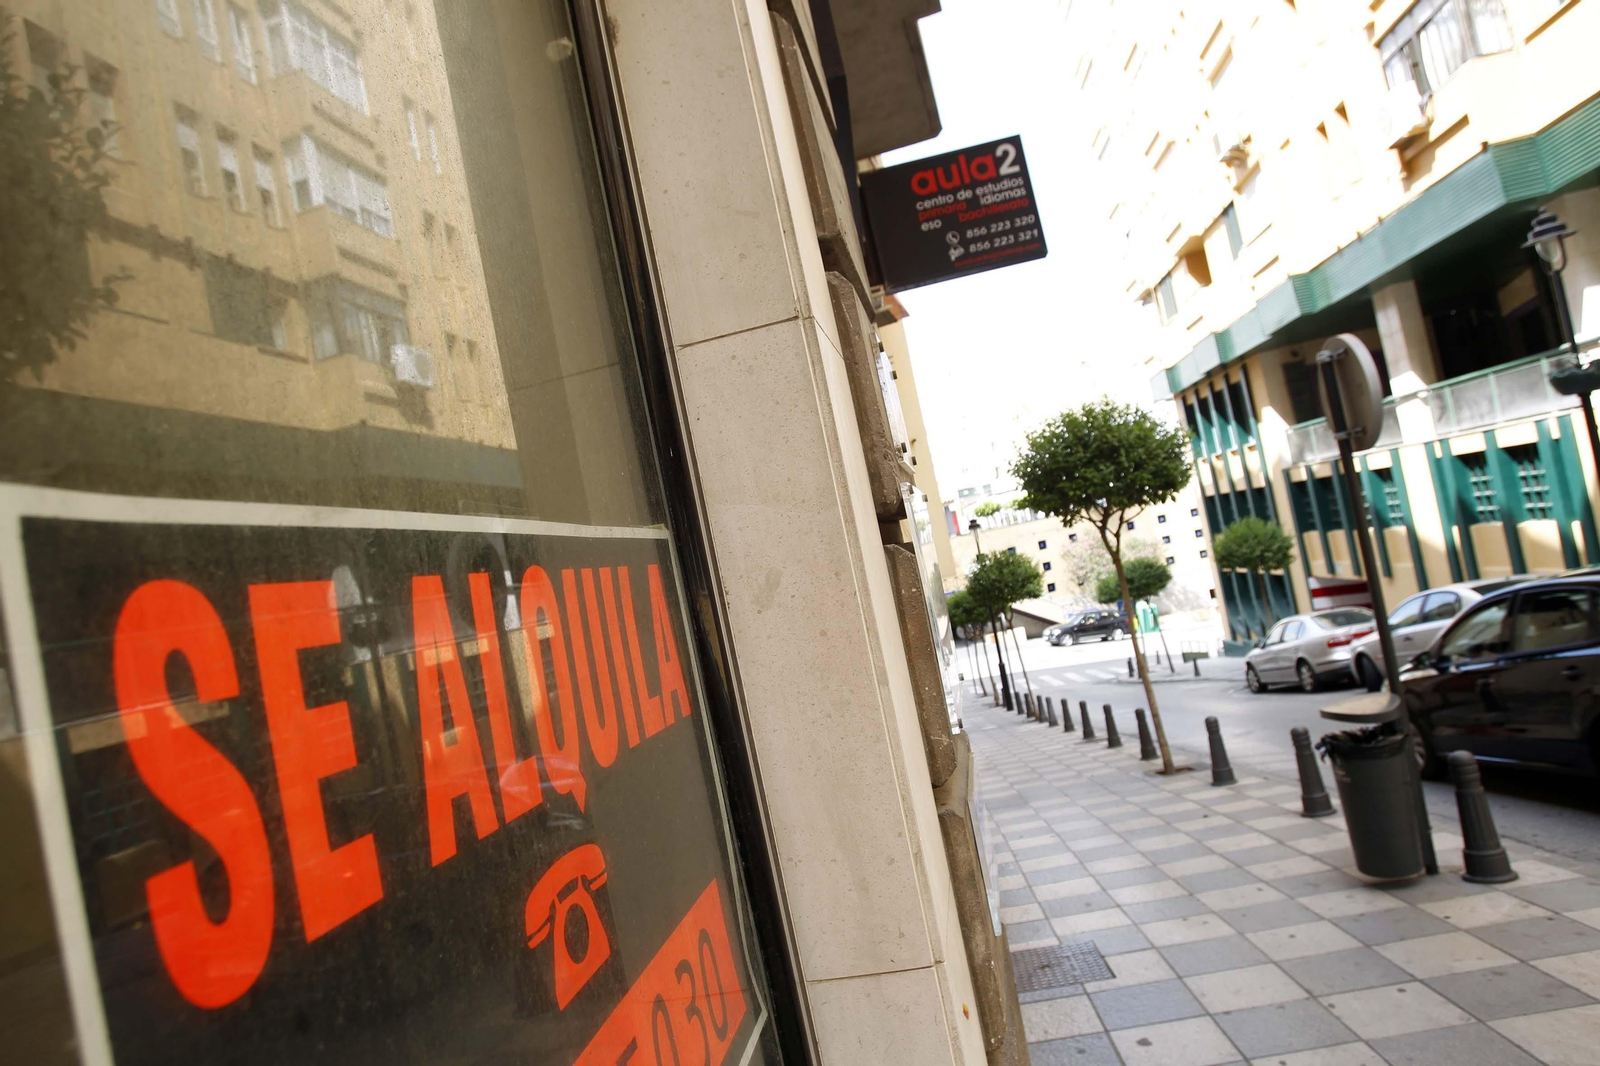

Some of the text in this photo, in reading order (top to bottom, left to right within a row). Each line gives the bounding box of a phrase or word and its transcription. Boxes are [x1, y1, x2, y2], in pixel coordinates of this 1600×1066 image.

[911, 142, 1021, 196] aula2
[916, 176, 1024, 211] centro de estudios
[979, 187, 1027, 206] idiomas
[918, 201, 967, 222] primaria
[958, 198, 1029, 223] bachillerato
[921, 219, 942, 232] eso
[966, 214, 1035, 239] 856 223 320
[969, 228, 1038, 253] 856 223 321
[112, 564, 692, 1010] SE ALQUILA
[615, 928, 729, 1066] 030
